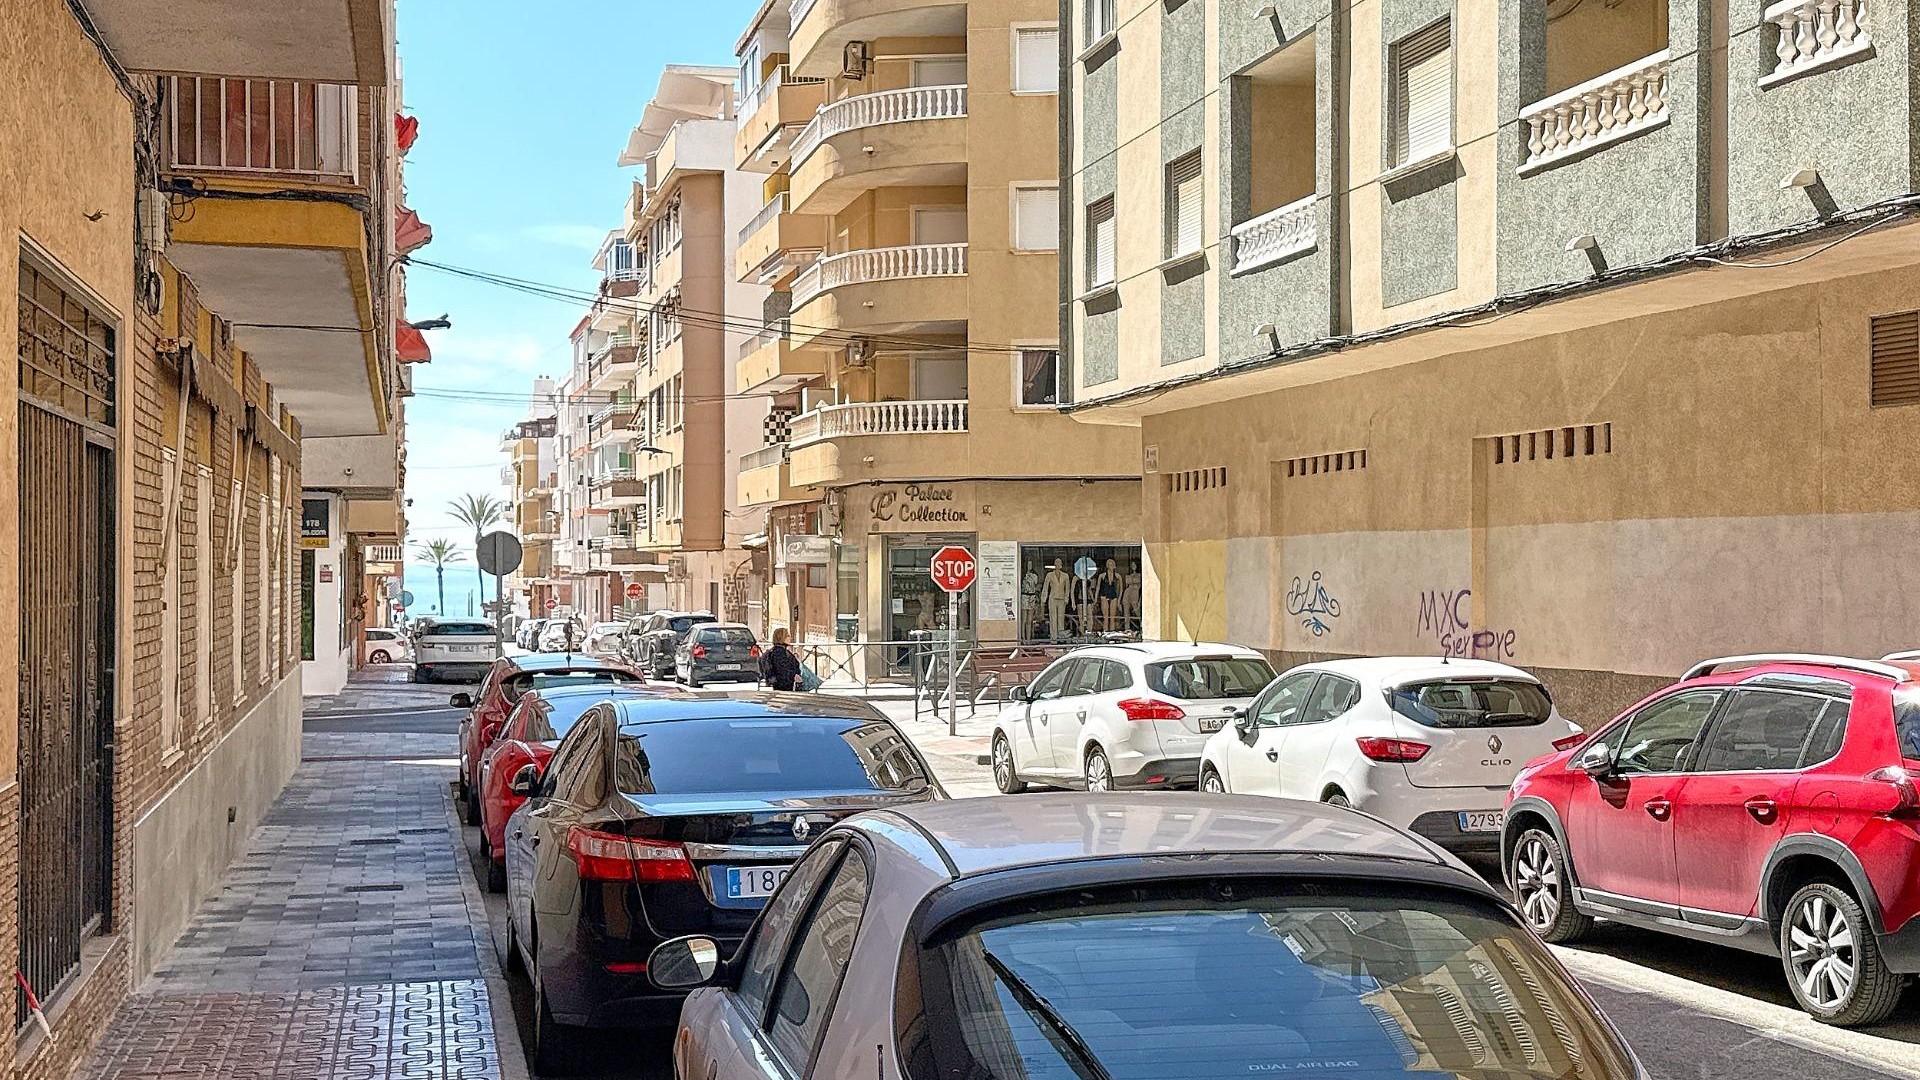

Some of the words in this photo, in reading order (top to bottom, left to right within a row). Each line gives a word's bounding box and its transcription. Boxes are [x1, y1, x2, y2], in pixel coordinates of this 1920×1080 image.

[905, 485, 952, 501] Palace
[899, 504, 968, 522] Collection
[935, 560, 974, 577] STOP
[1417, 589, 1471, 638] MXC
[1469, 813, 1504, 828] 2793
[1248, 1063, 1290, 1071] DUAL
[1324, 1060, 1359, 1068] BAG
